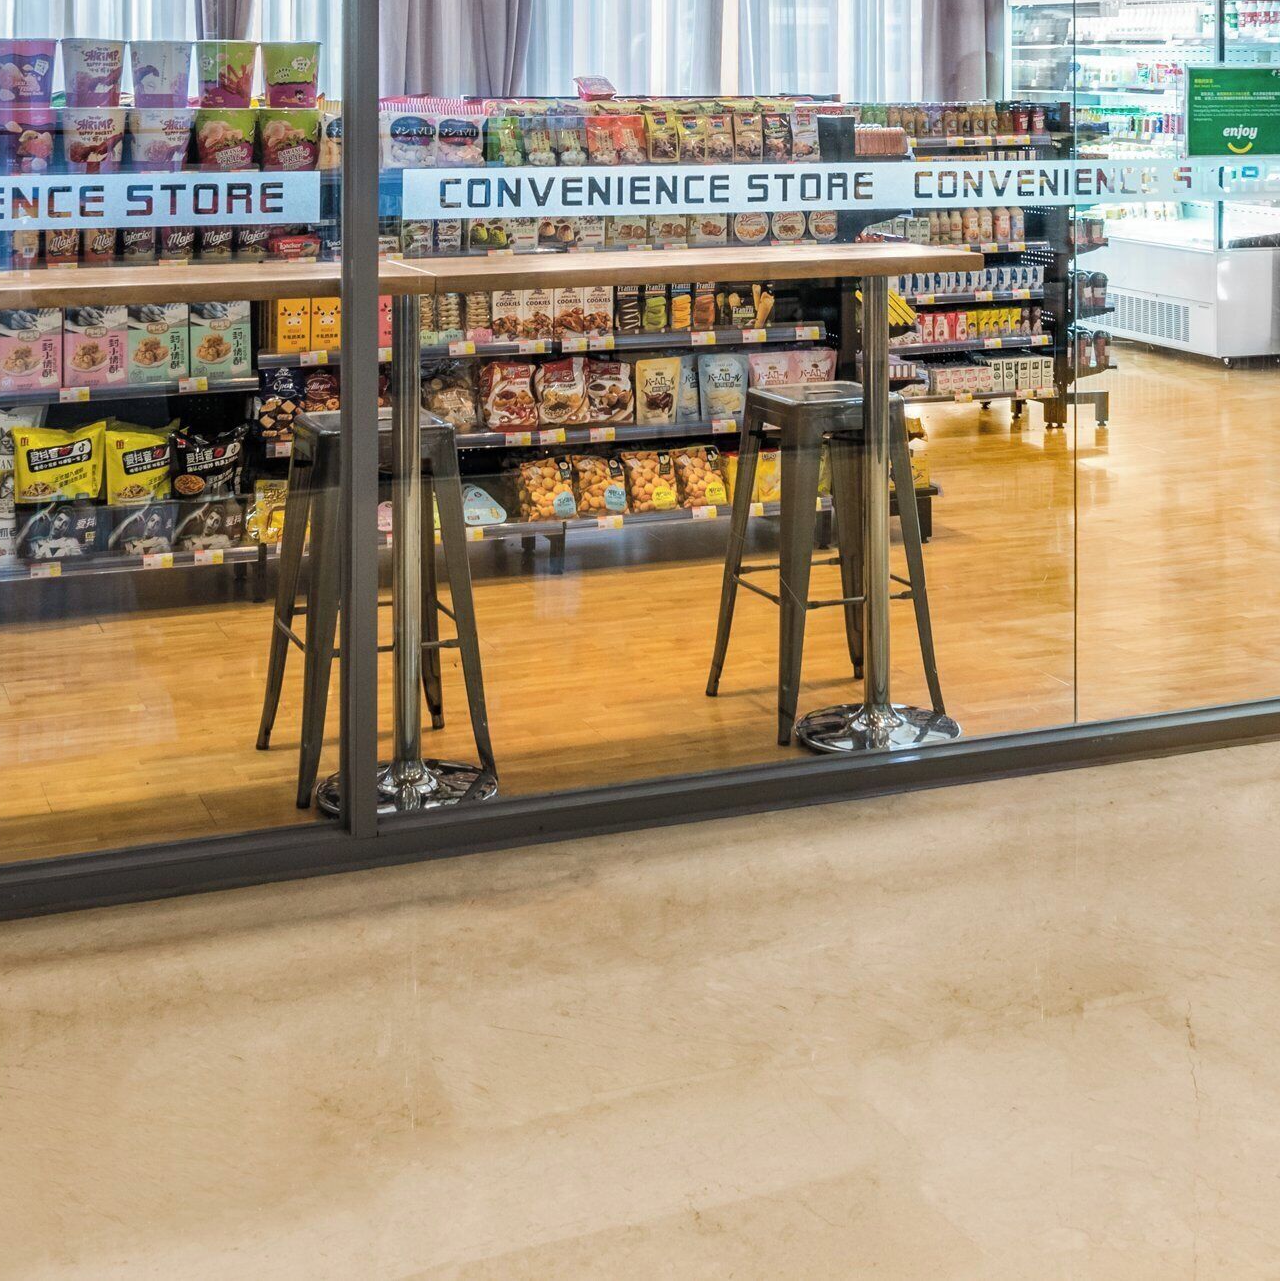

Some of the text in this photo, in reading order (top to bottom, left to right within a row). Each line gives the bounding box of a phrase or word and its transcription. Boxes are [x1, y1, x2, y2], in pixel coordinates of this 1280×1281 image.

[1223, 124, 1258, 139] enjoy
[127, 181, 284, 217] STORE
[439, 171, 874, 209] CONVENIENCE STORE
[914, 167, 1159, 199] CONVENIENCE
